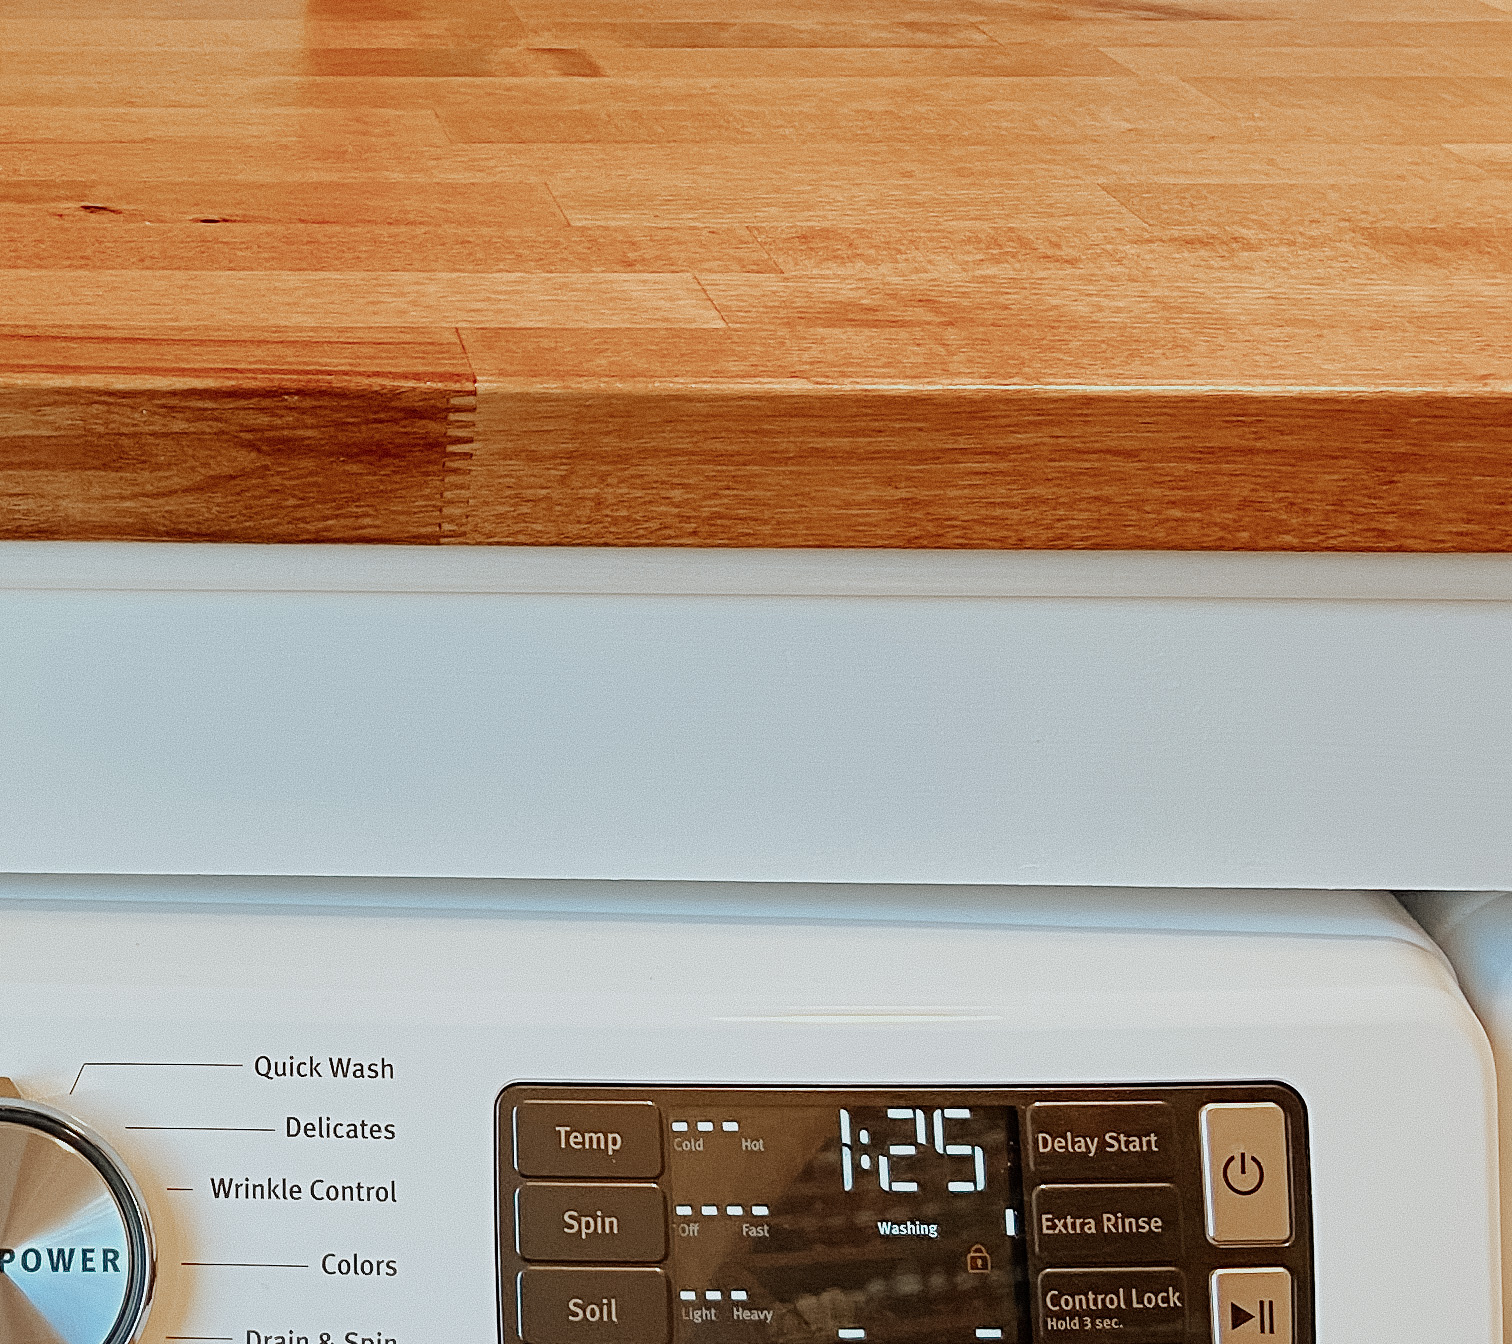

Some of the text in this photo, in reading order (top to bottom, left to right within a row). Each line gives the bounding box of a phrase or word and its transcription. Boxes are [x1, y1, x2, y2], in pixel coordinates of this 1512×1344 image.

[254, 1055, 395, 1080] Quick Wash
[285, 1116, 396, 1140] Delicates
[555, 1126, 623, 1155] Temp
[673, 1138, 765, 1152] Cold Hot
[839, 1108, 986, 1192] 1:25
[1037, 1131, 1159, 1157] Delay Start
[210, 1177, 397, 1203] Wrinkle Control
[563, 1210, 619, 1239] Spin
[678, 1222, 770, 1238] Off Fast
[877, 1219, 939, 1239] Washing
[1041, 1213, 1163, 1235] Extra Rinse
[321, 1253, 398, 1277] Colors
[1045, 1286, 1183, 1311] Control Lock
[567, 1299, 619, 1324] Soil
[682, 1307, 774, 1323] Light Heavy
[1047, 1316, 1124, 1331] Hold 3 sec.
